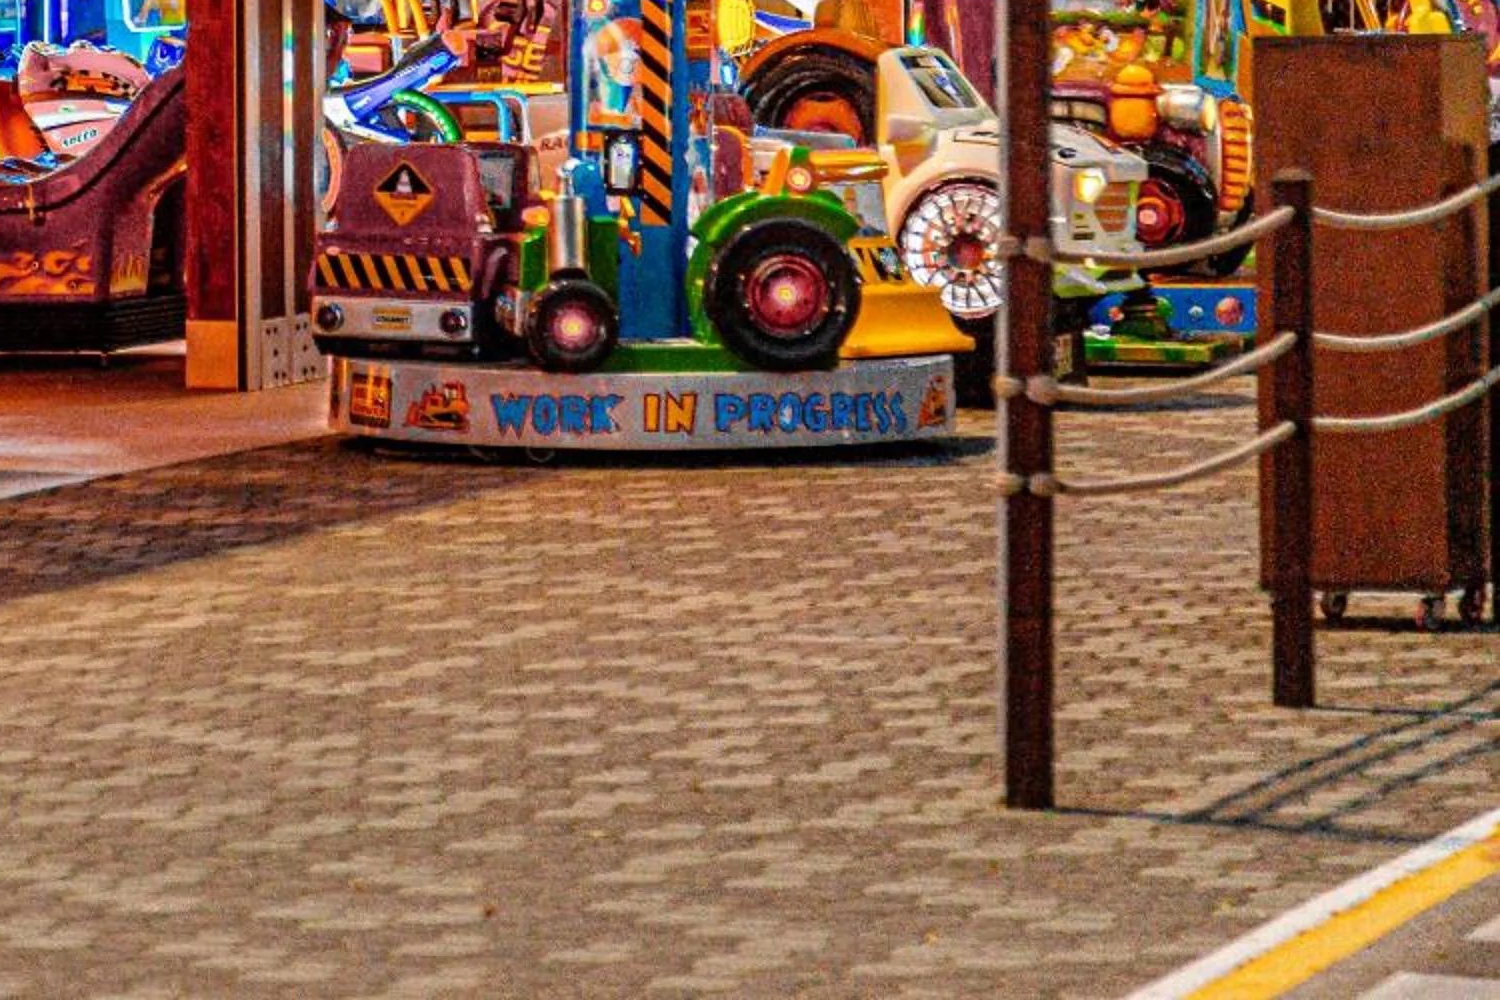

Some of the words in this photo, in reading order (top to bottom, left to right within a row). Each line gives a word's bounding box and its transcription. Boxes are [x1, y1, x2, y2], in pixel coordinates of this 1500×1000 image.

[489, 391, 625, 436] WORK
[642, 389, 698, 434] IN
[712, 390, 908, 435] PROGRESS
